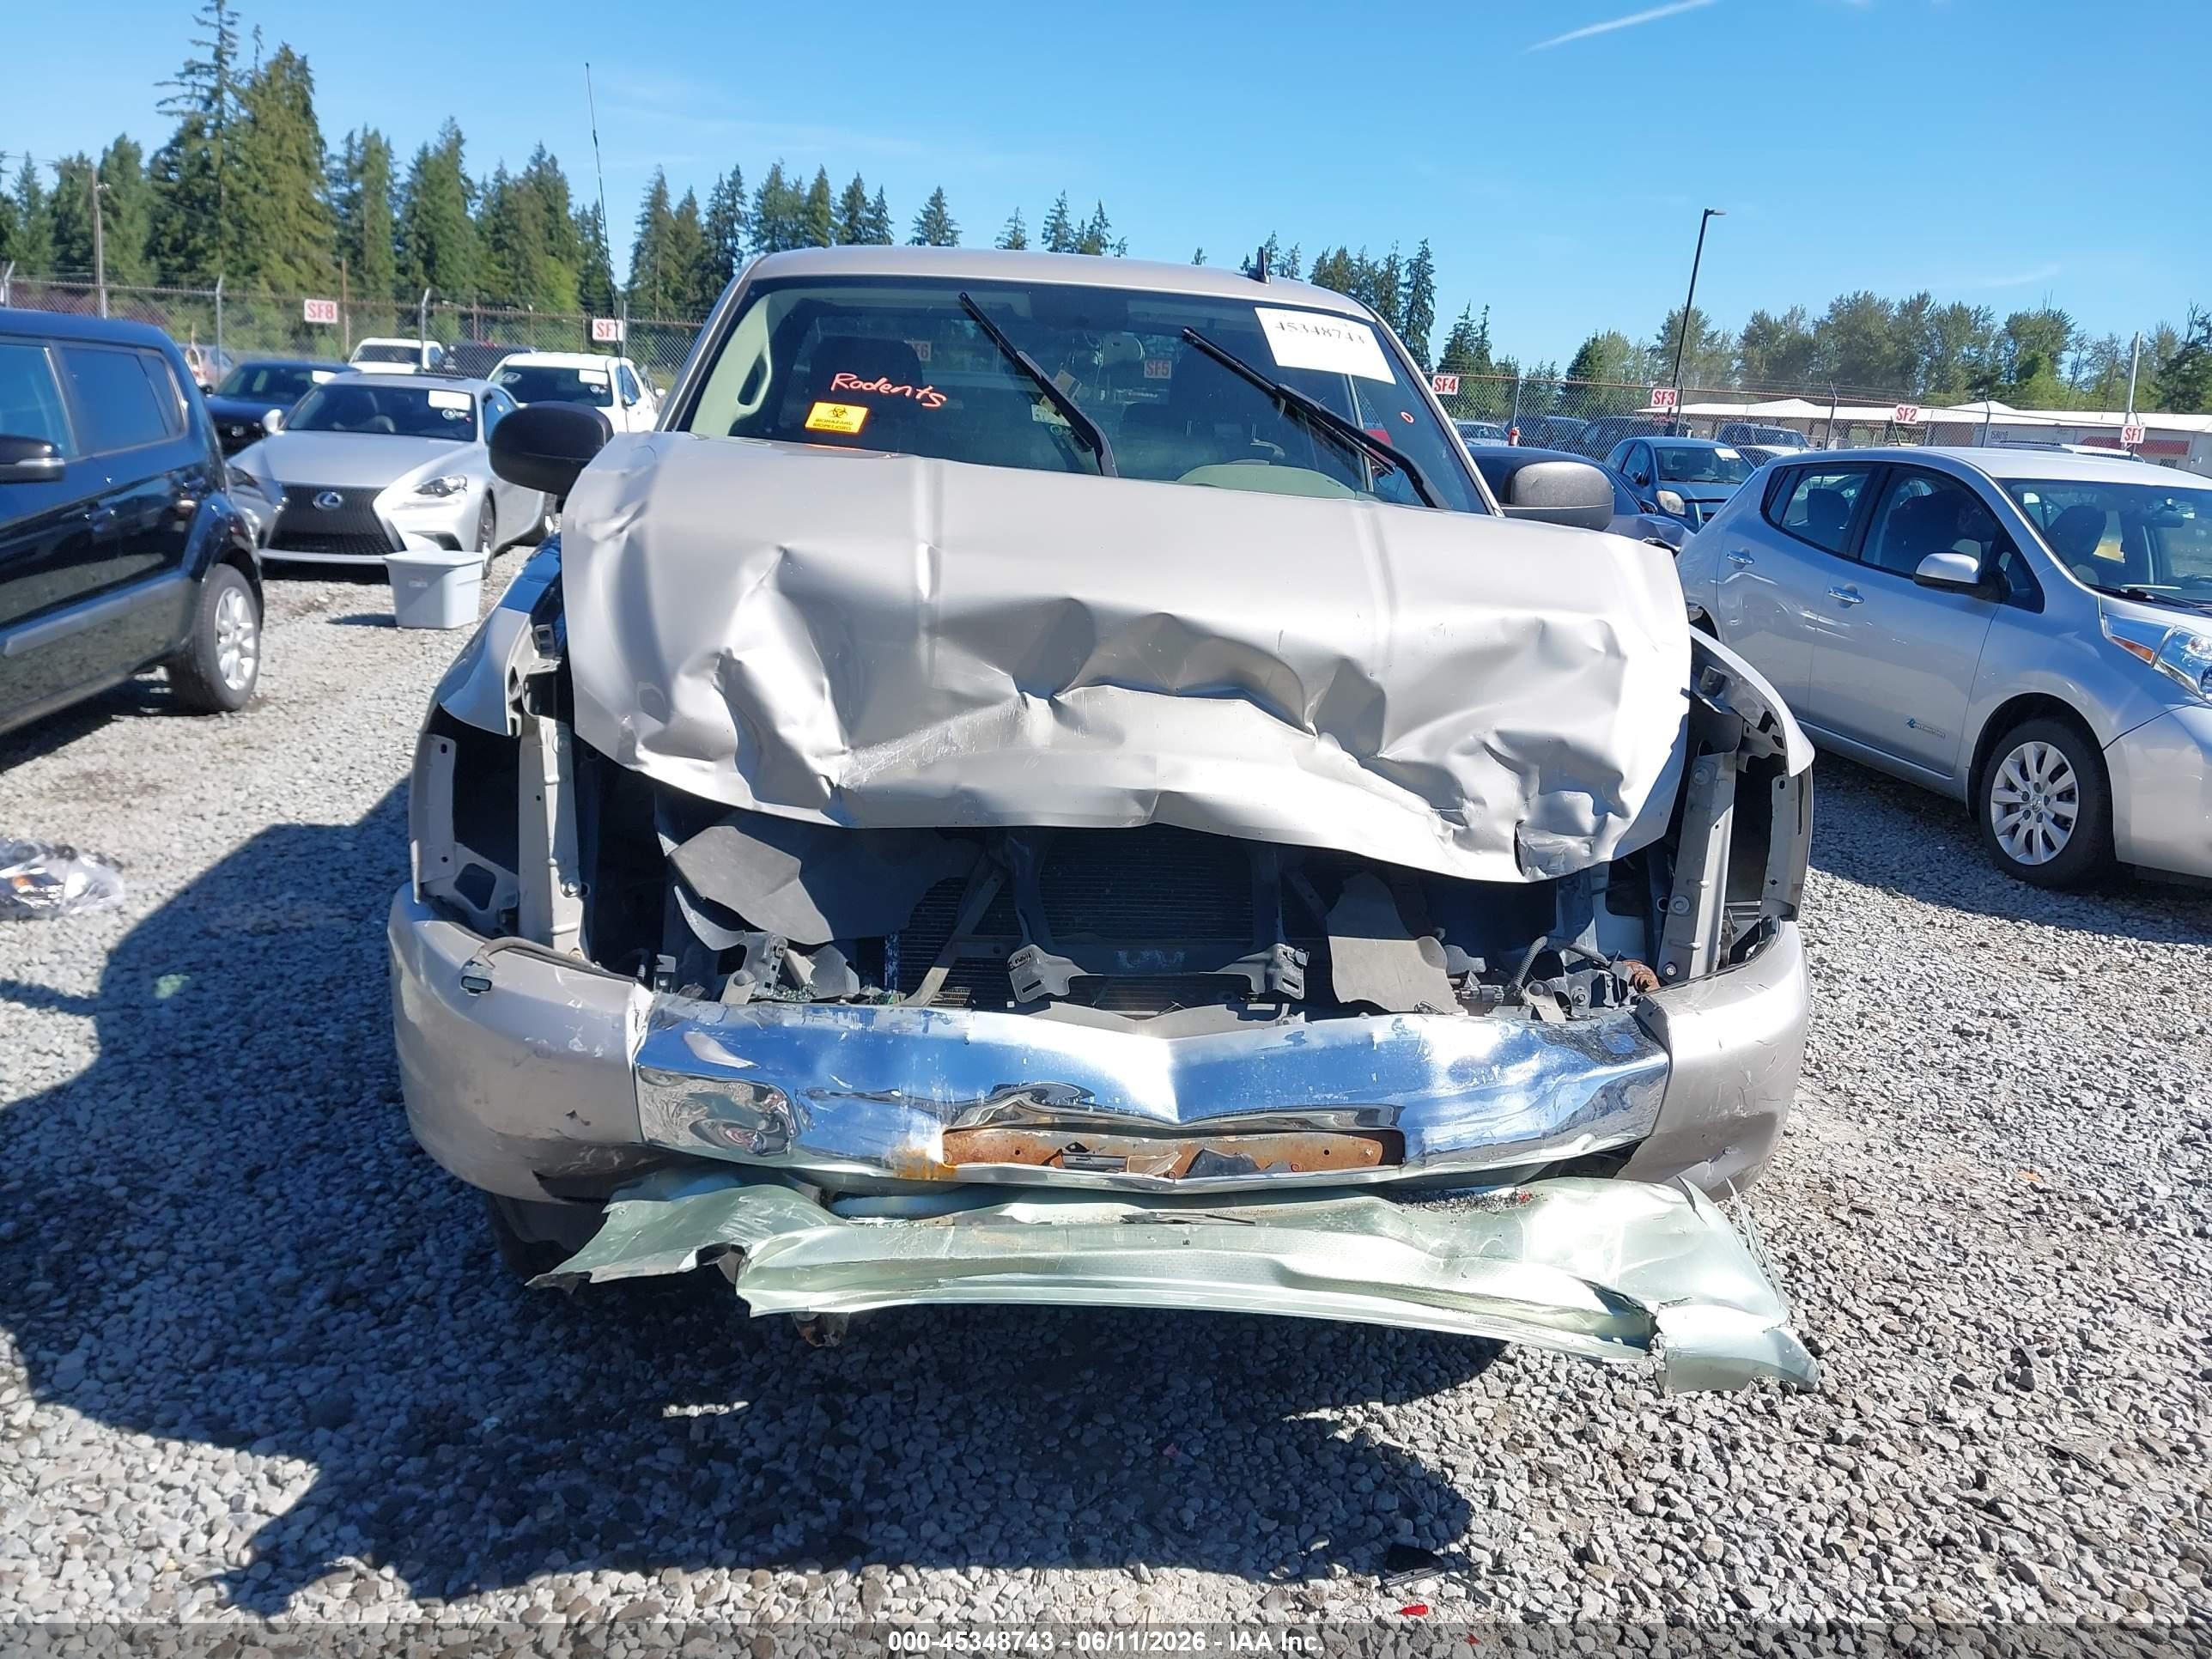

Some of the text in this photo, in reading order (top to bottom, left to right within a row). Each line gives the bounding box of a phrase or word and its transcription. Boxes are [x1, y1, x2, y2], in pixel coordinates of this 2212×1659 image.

[307, 302, 334, 319] SF8
[1146, 361, 1169, 376] SF5
[830, 373, 947, 408] Rodents
[1434, 377, 1456, 392] SF4
[1654, 390, 1675, 405] SF3
[1896, 407, 1917, 422] SF2
[2124, 427, 2142, 441] SF1
